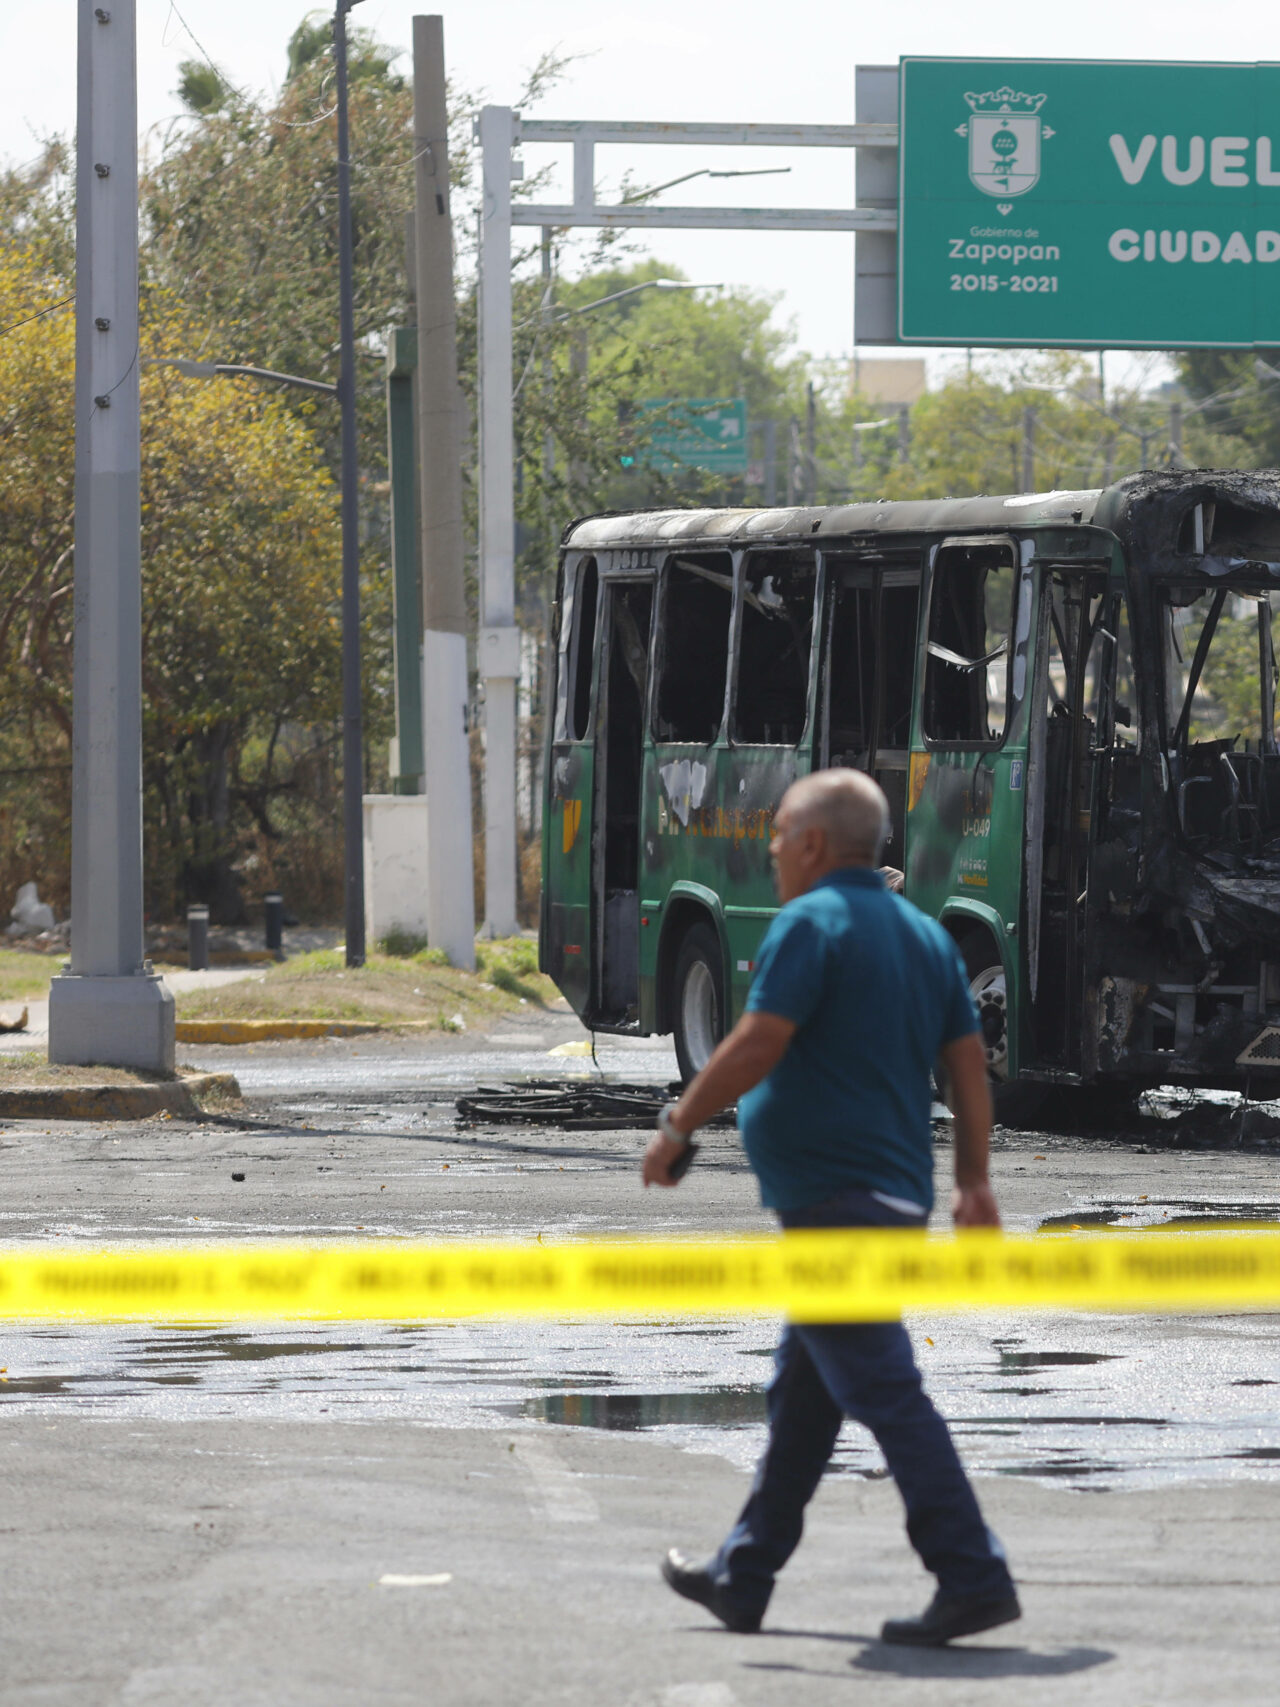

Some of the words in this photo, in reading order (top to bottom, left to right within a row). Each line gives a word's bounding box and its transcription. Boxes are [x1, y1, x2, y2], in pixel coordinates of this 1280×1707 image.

[970, 226, 1022, 238] Gobierno
[1024, 228, 1040, 239] de
[948, 238, 1060, 265] Zapopan
[950, 274, 1058, 292] 2015-2021
[962, 818, 991, 837] U-049
